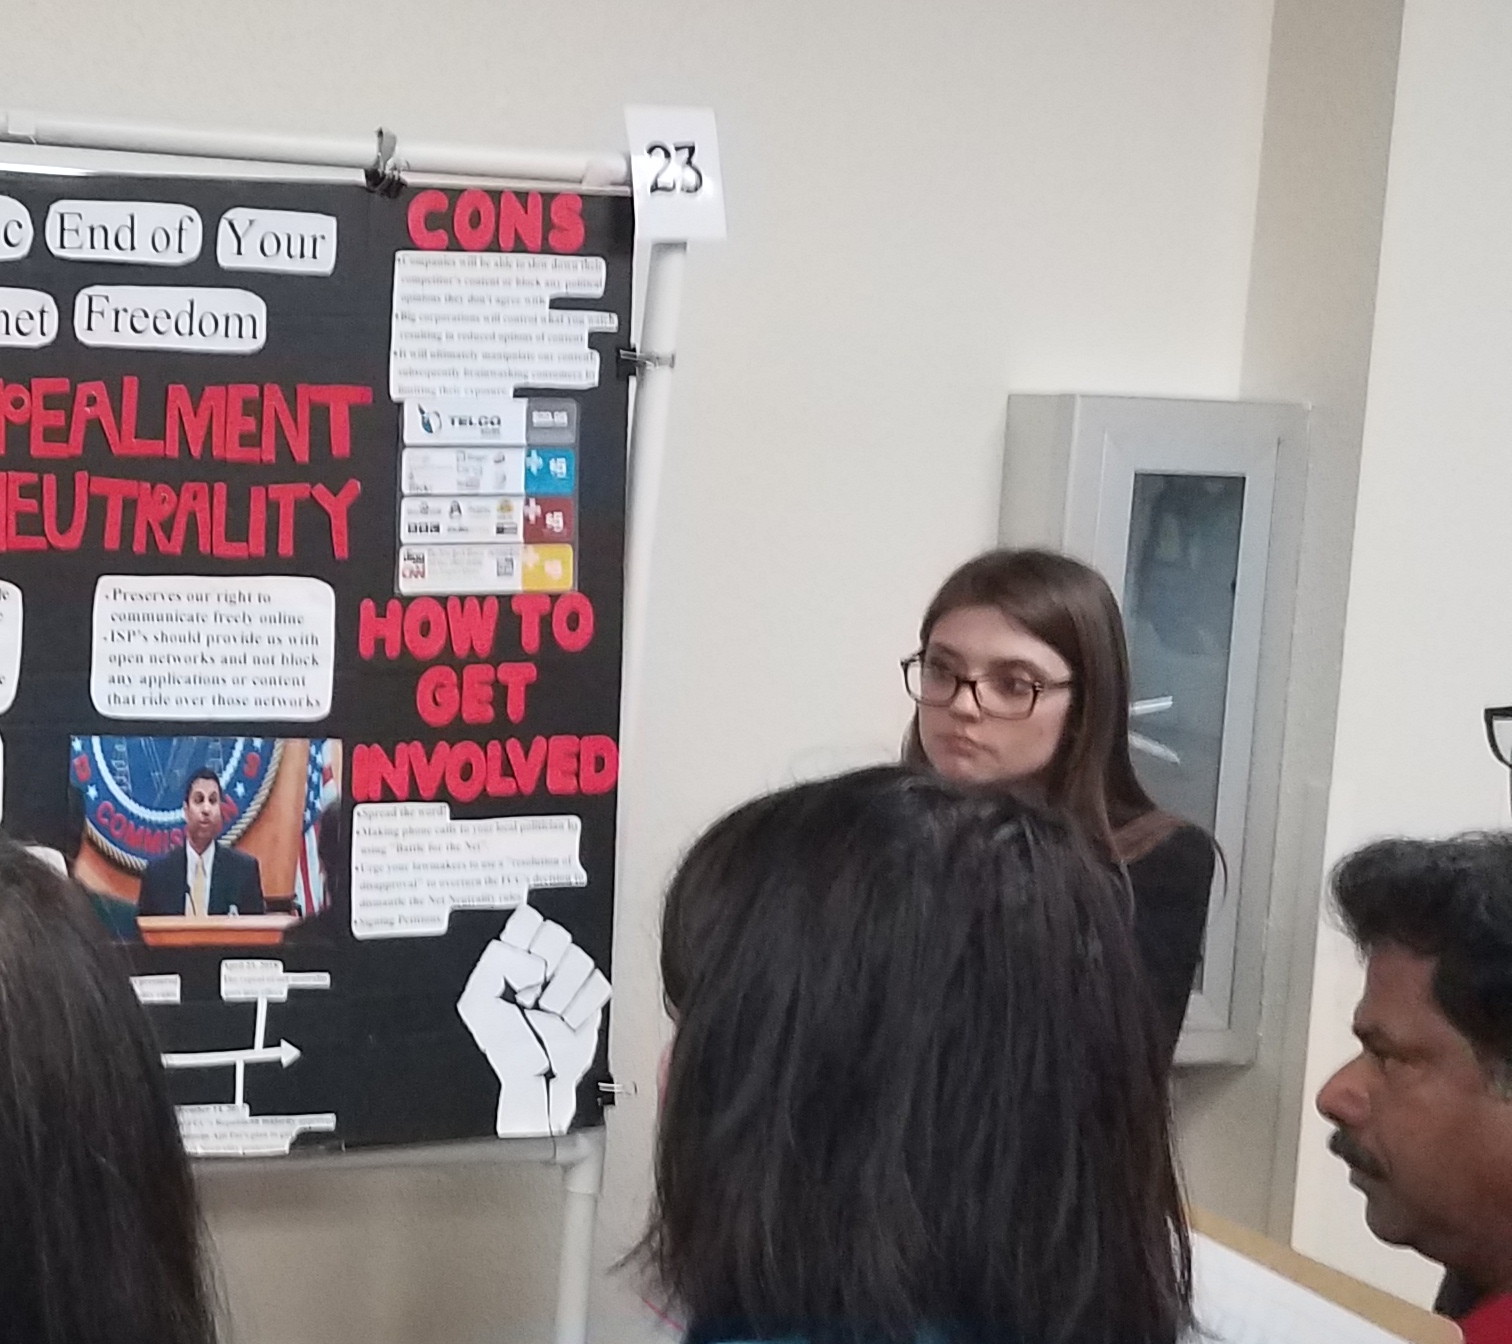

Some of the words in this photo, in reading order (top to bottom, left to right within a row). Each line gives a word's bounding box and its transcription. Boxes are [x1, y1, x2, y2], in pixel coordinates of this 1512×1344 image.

[645, 140, 703, 195] 23
[56, 212, 138, 252] End
[152, 214, 194, 253] of
[223, 218, 327, 260] Your
[407, 190, 585, 252] CONS
[84, 294, 259, 340] Freedom
[110, 611, 208, 624] communicate
[213, 611, 252, 625] freely
[259, 611, 304, 625] online
[112, 588, 181, 602] Preserves
[187, 593, 210, 603] our
[216, 591, 252, 606] right
[257, 592, 271, 603] to
[110, 630, 148, 642] ISP's
[153, 631, 201, 644] should
[206, 632, 261, 647] provide
[267, 636, 282, 645] us
[288, 633, 319, 646] with
[357, 597, 500, 659] HOW
[510, 592, 595, 654] TO
[108, 675, 132, 687] any
[139, 672, 227, 689] applications
[231, 676, 247, 686] or
[252, 675, 306, 687] content
[109, 654, 143, 667] open
[149, 652, 215, 665] networks
[220, 652, 247, 665] and
[253, 653, 275, 666] not
[281, 653, 319, 666] block
[107, 693, 135, 706] that
[142, 693, 170, 706] ride
[175, 695, 205, 706] over
[212, 693, 248, 706] those
[254, 694, 320, 707] networks
[415, 662, 538, 726] GET
[351, 735, 619, 802] INVOLVED
[96, 794, 238, 854] COMMISN
